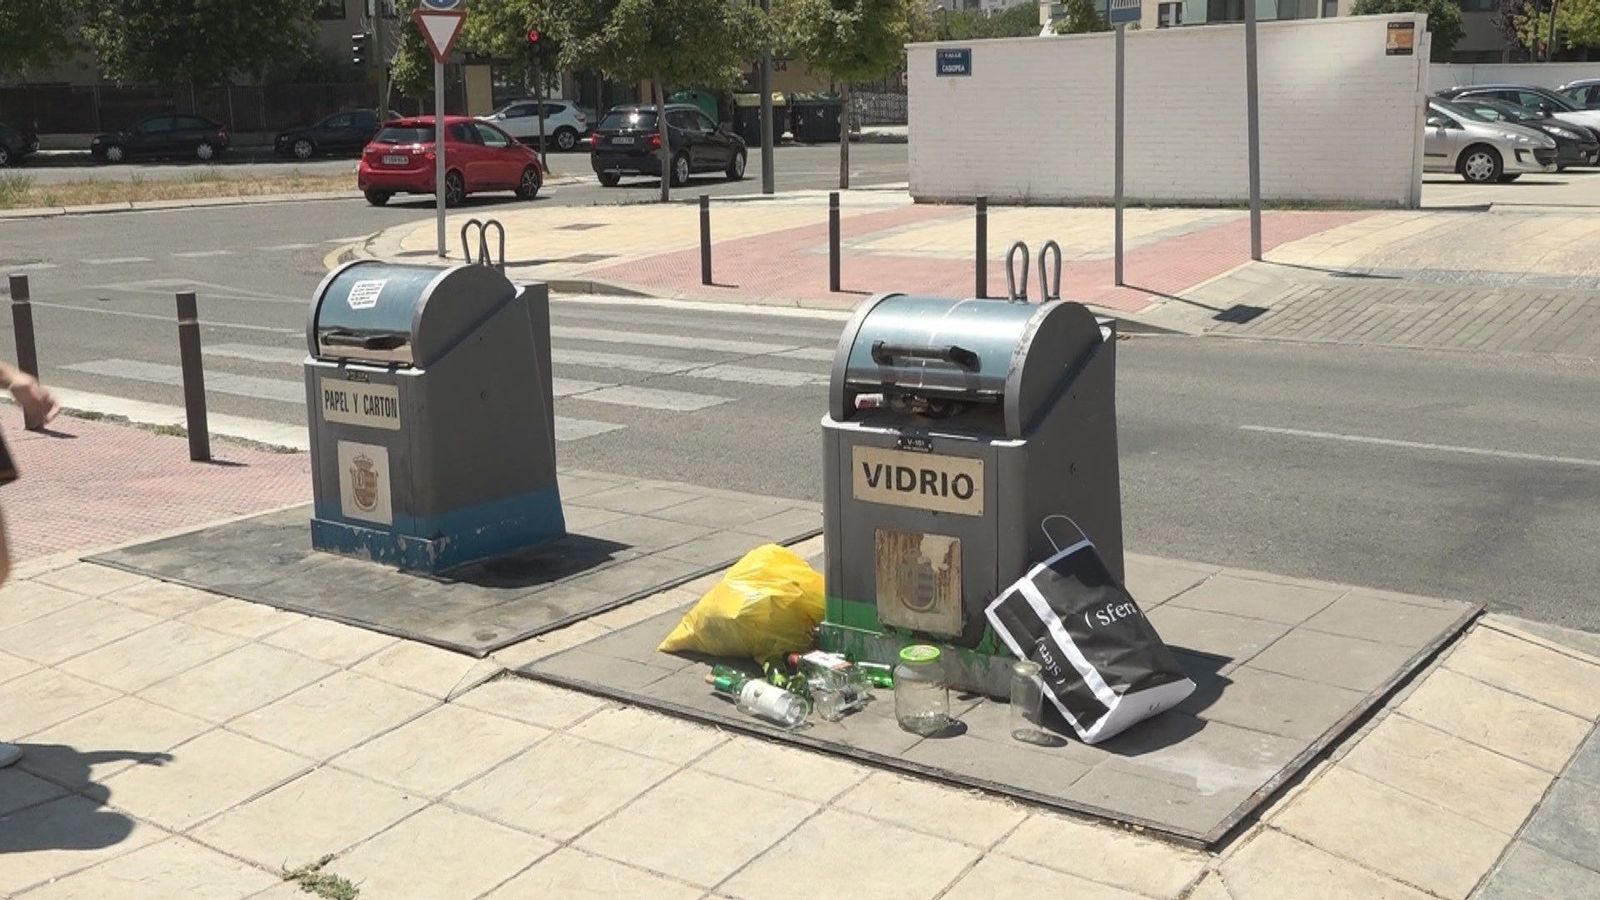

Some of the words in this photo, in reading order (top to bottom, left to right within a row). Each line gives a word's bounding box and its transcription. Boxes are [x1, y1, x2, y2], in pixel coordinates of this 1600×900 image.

[324, 390, 349, 413] PAPEL
[352, 393, 358, 414] Y
[363, 394, 398, 419] CARTON
[862, 461, 974, 501] VIDRIO
